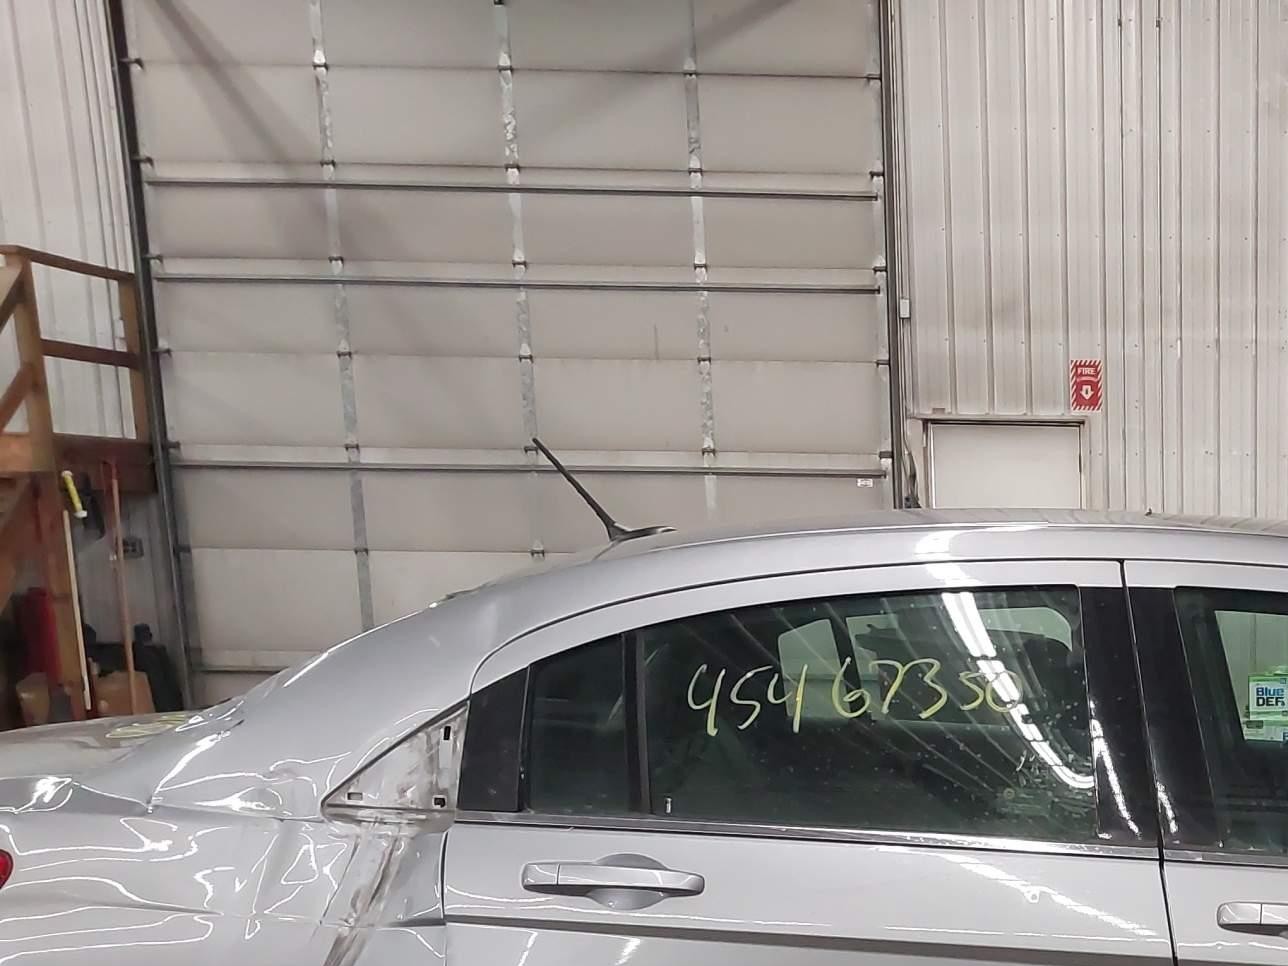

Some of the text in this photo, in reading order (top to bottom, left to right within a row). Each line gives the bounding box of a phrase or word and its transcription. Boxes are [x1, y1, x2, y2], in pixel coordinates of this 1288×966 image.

[1077, 367, 1097, 375] FIRE
[1256, 686, 1285, 697] Blue
[1256, 697, 1286, 707] DEF
